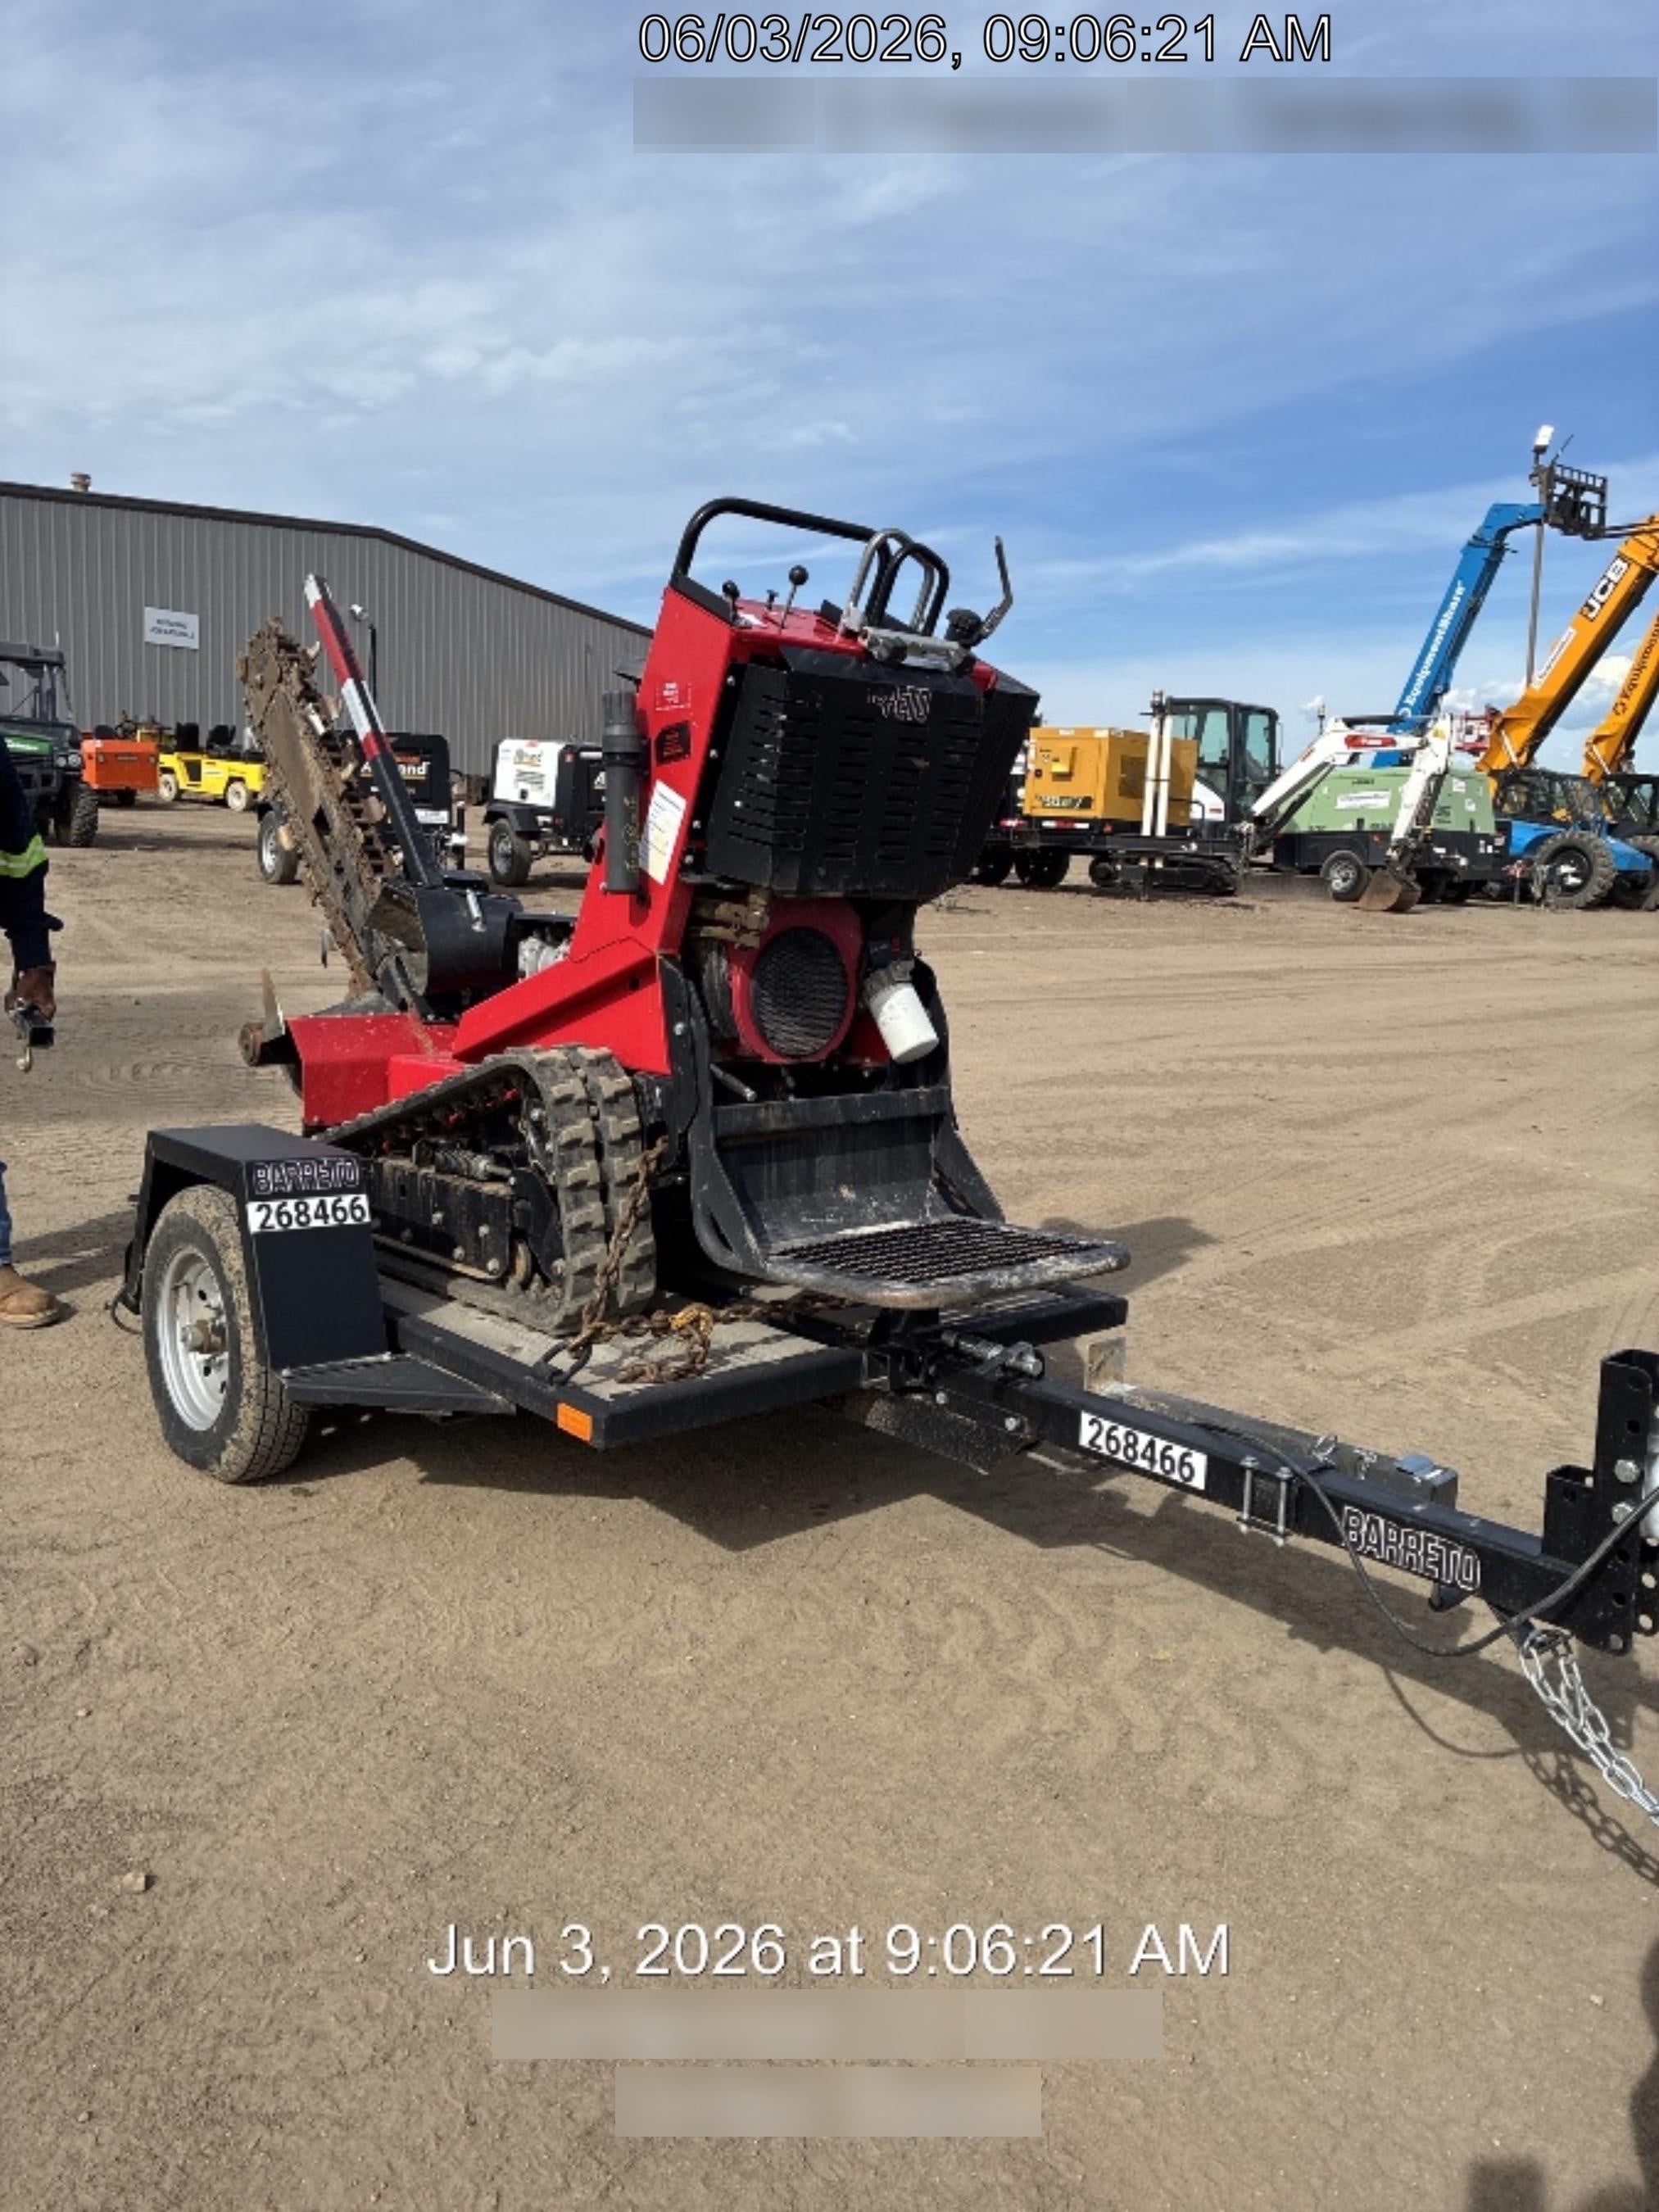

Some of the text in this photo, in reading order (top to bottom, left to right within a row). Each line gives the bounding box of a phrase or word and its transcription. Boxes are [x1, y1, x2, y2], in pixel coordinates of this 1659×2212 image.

[1586, 558, 1629, 619] JCB
[253, 1158, 360, 1194] BARRETO
[256, 1195, 366, 1230] 268466
[1087, 1416, 1195, 1483] 268466
[1342, 1506, 1480, 1590] BARRETO
